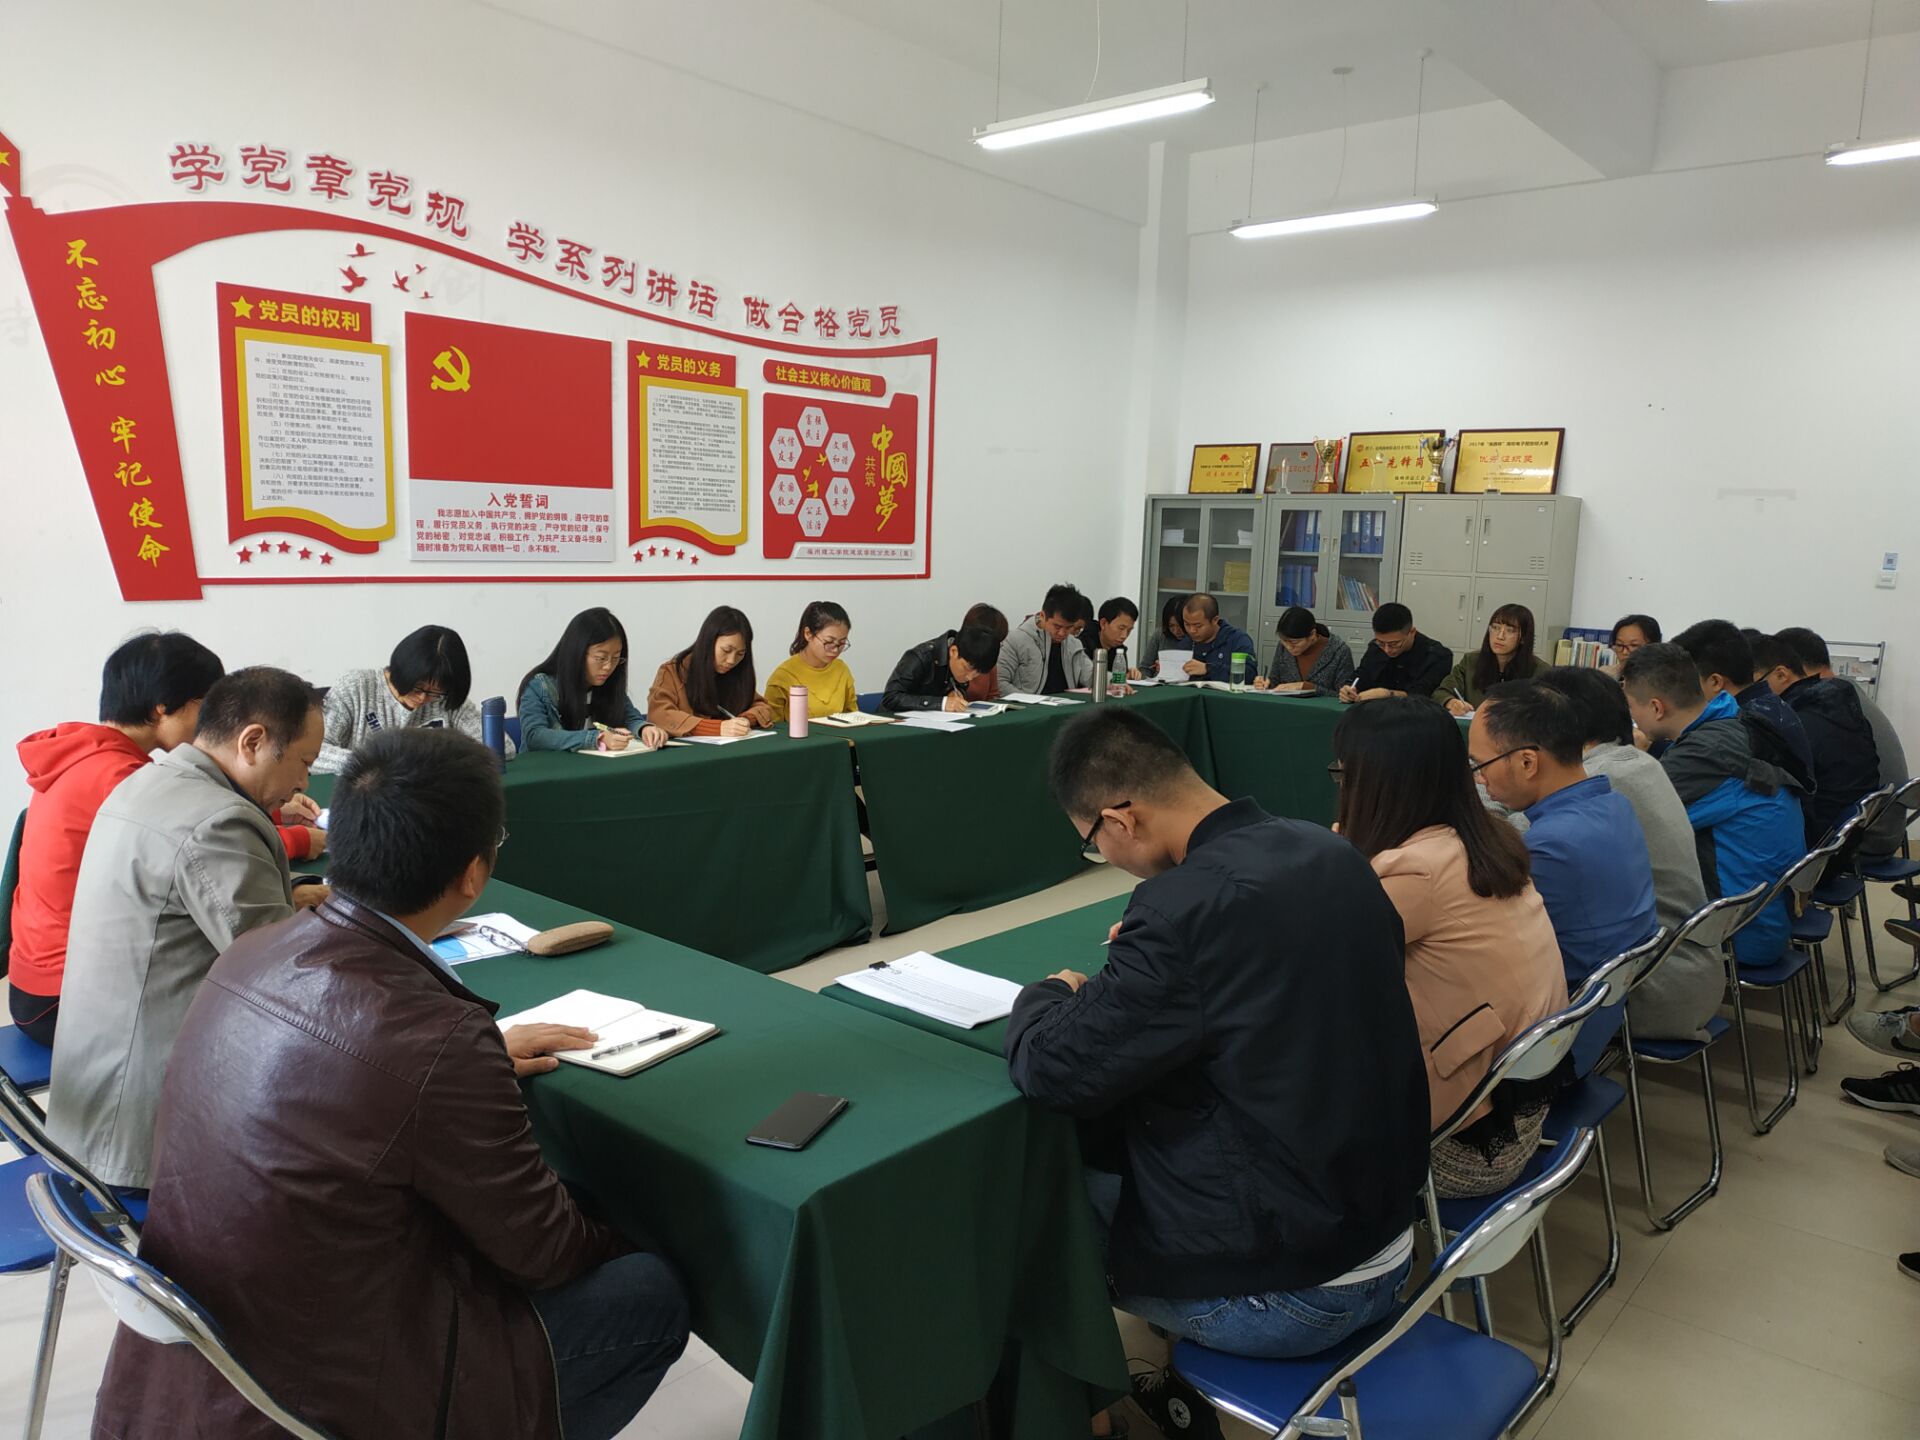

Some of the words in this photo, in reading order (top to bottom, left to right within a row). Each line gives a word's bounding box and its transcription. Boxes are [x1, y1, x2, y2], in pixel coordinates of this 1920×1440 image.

[170, 143, 468, 238] 学党章党规
[506, 222, 718, 318] 学系列讲话
[743, 296, 902, 339] 做合格党员
[259, 299, 361, 332] 党员的权利
[656, 353, 721, 378] 党员的义务
[776, 365, 871, 393] 社会主义核心价值观
[66, 239, 126, 386] 不忘初心
[110, 415, 170, 567] 牢记使命
[864, 456, 876, 488] 共筑
[487, 492, 549, 509] 入党誓词
